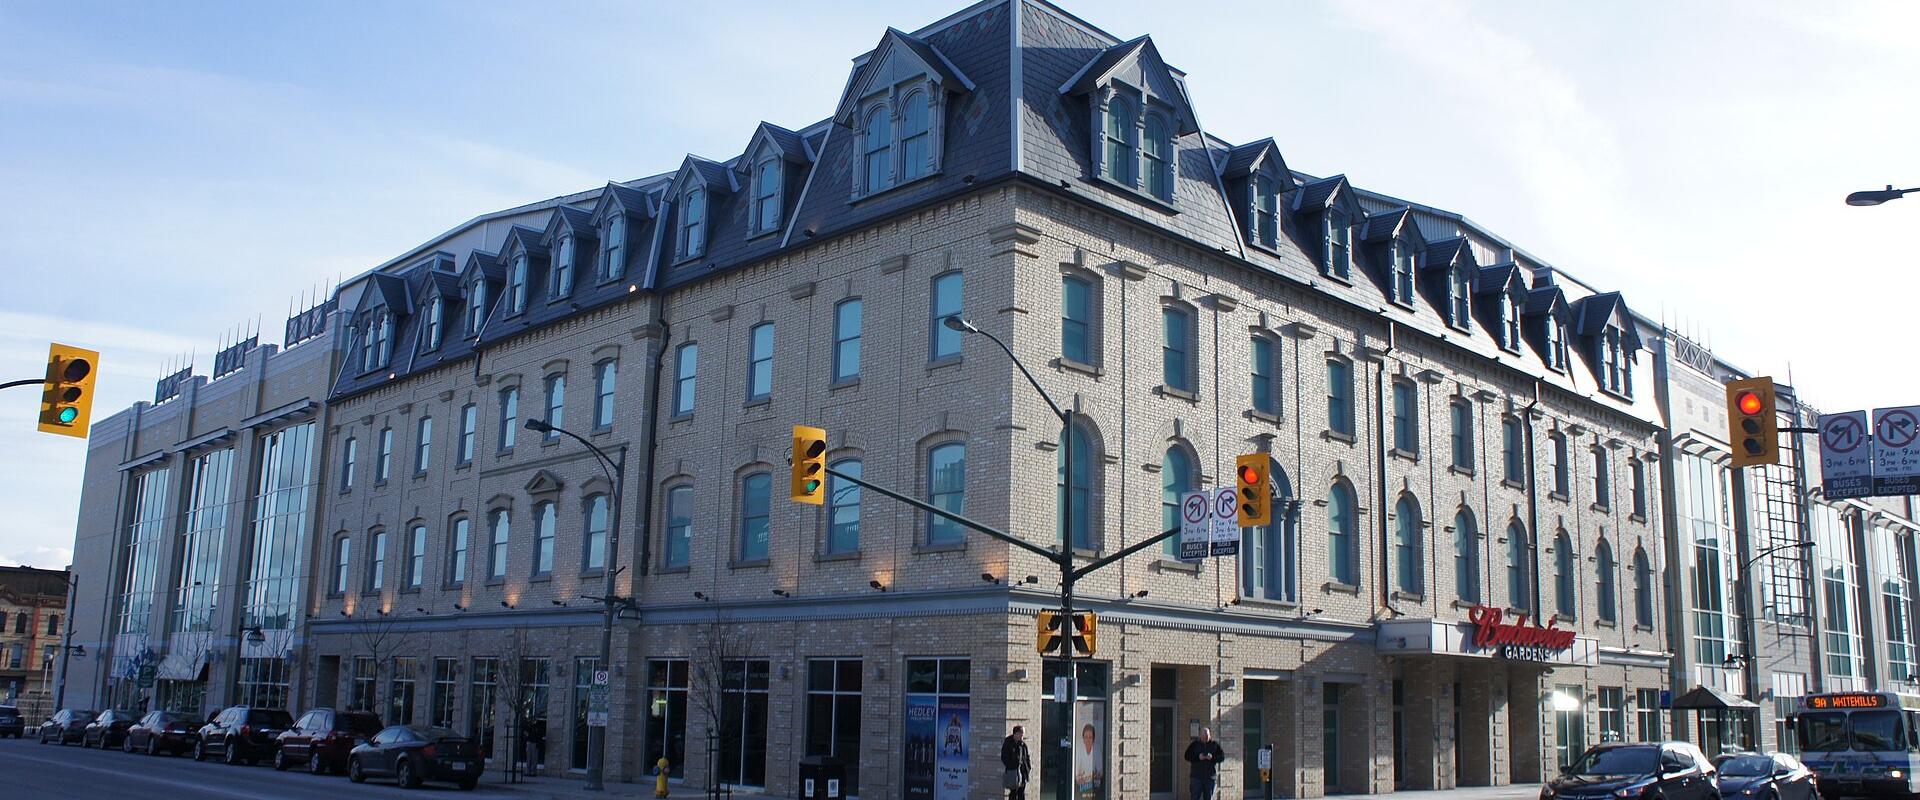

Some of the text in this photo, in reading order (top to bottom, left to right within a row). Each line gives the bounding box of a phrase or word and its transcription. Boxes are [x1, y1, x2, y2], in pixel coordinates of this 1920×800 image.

[1879, 449, 1896, 457] 7AM
[1832, 479, 1861, 488] BUSES
[1826, 487, 1869, 497] EXCEPTED
[1878, 485, 1917, 494] EXCEPTED
[1505, 646, 1550, 662] GARDENS
[1814, 696, 1878, 708] 9A WHITEHILLS
[909, 706, 935, 717] HEDLEY
